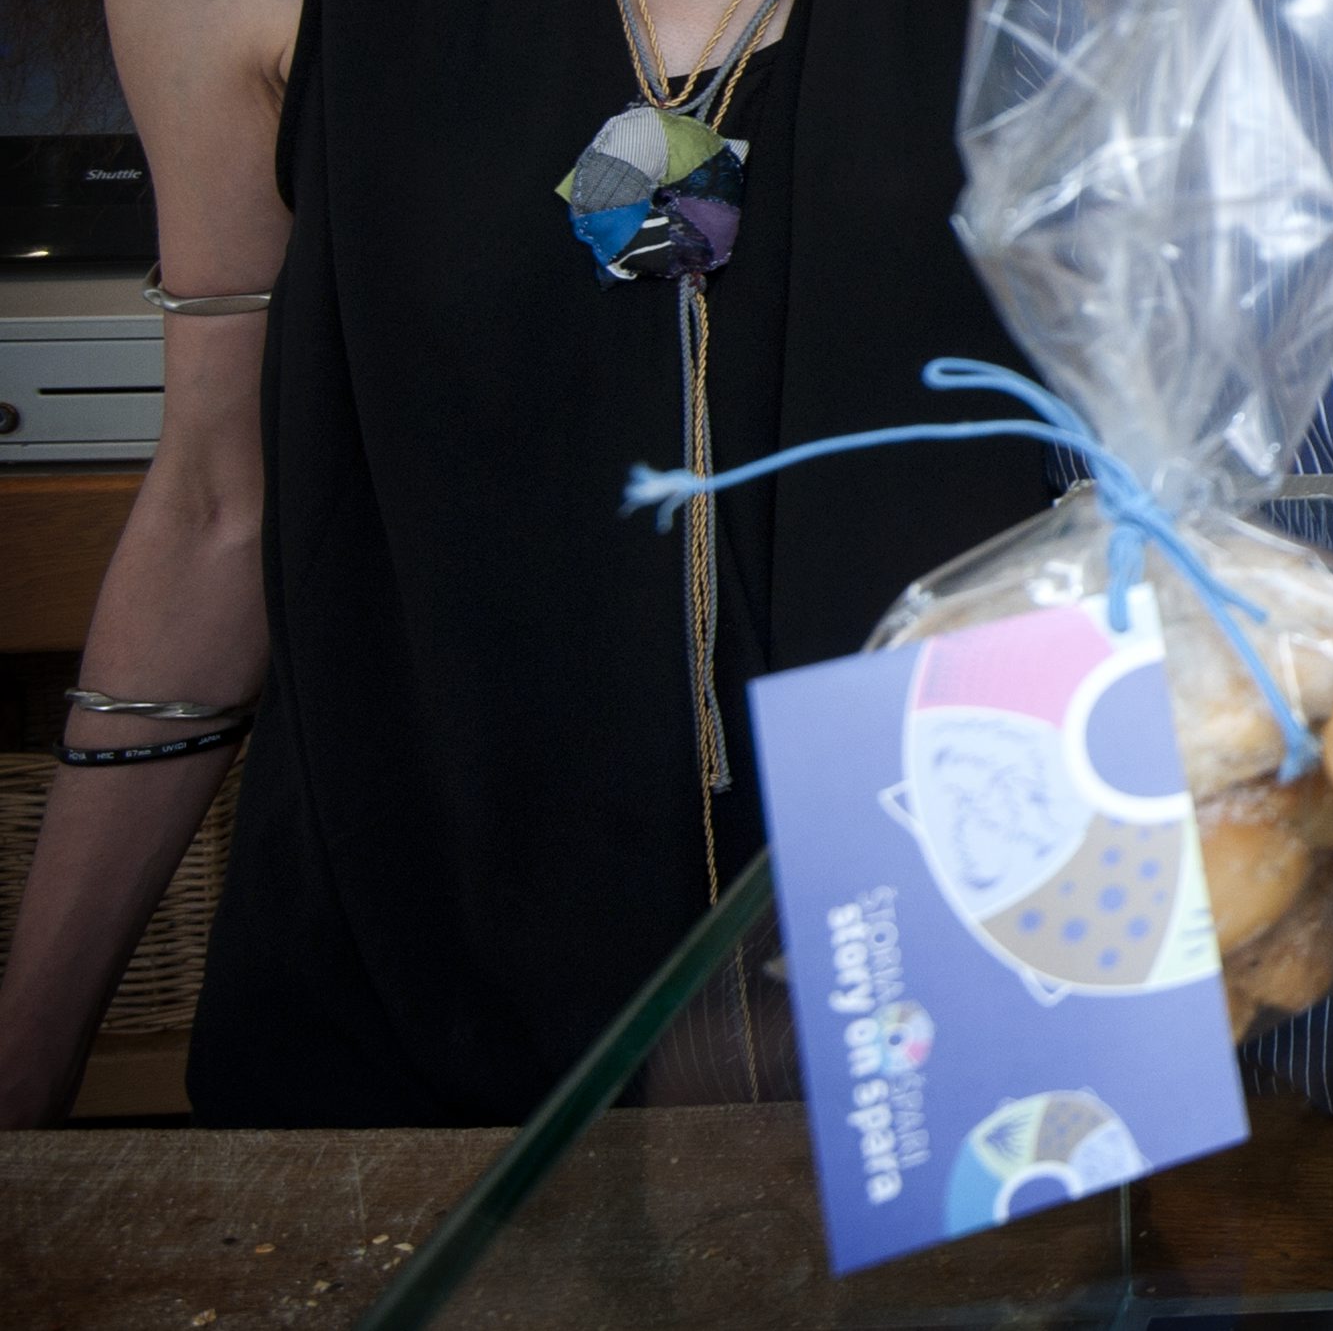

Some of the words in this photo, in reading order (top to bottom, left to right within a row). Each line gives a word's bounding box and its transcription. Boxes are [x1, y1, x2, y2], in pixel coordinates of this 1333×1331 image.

[86, 169, 142, 180] Shuttle
[827, 902, 876, 1014] story
[843, 1016, 884, 1078] on
[847, 1078, 903, 1205] spara
